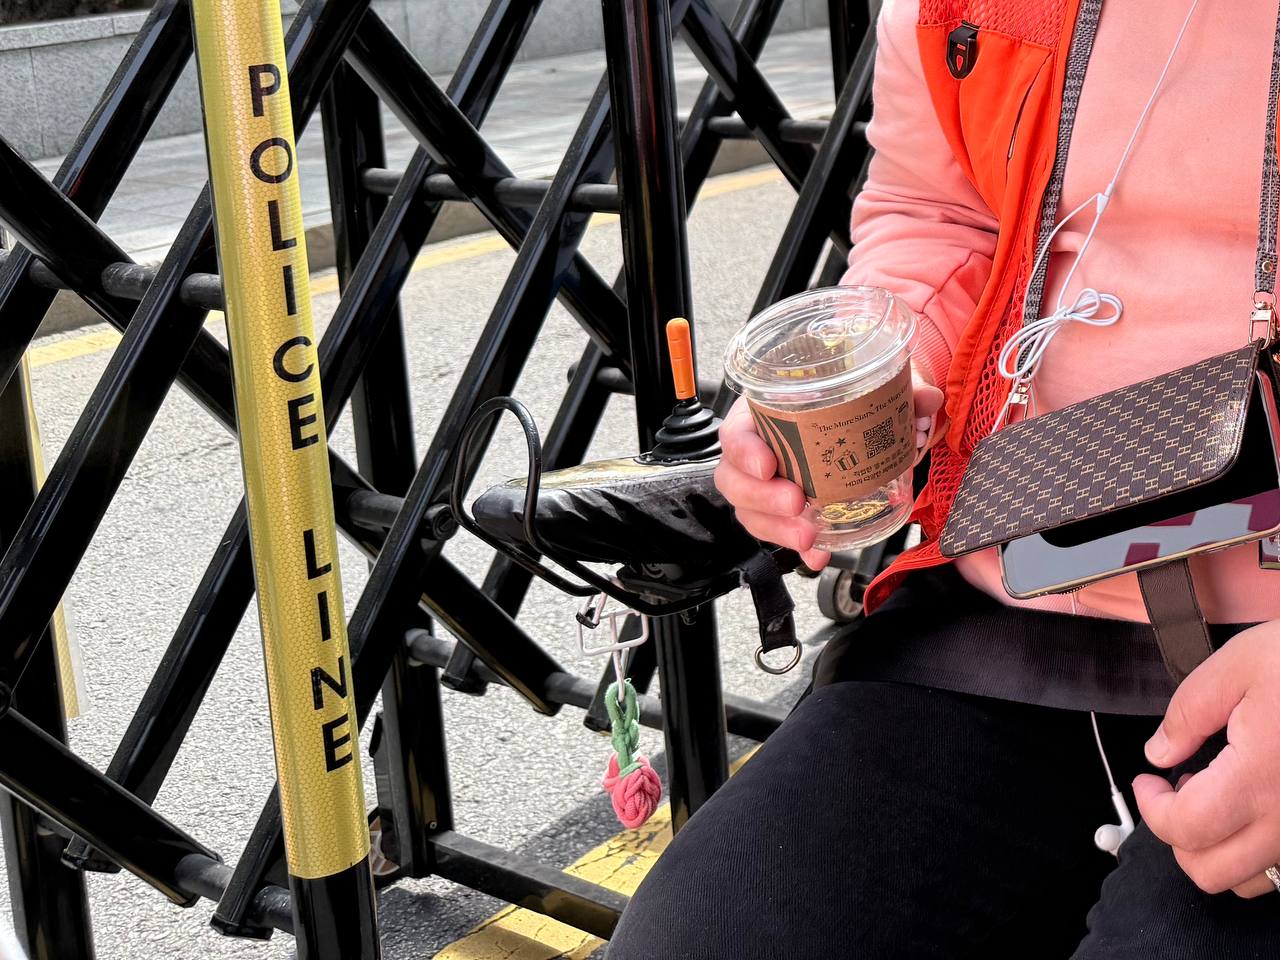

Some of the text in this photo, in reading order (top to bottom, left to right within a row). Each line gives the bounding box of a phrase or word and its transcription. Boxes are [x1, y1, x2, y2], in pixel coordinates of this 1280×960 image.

[248, 63, 353, 773] POLICE LINE
[818, 424, 833, 433] The
[833, 418, 854, 429] More
